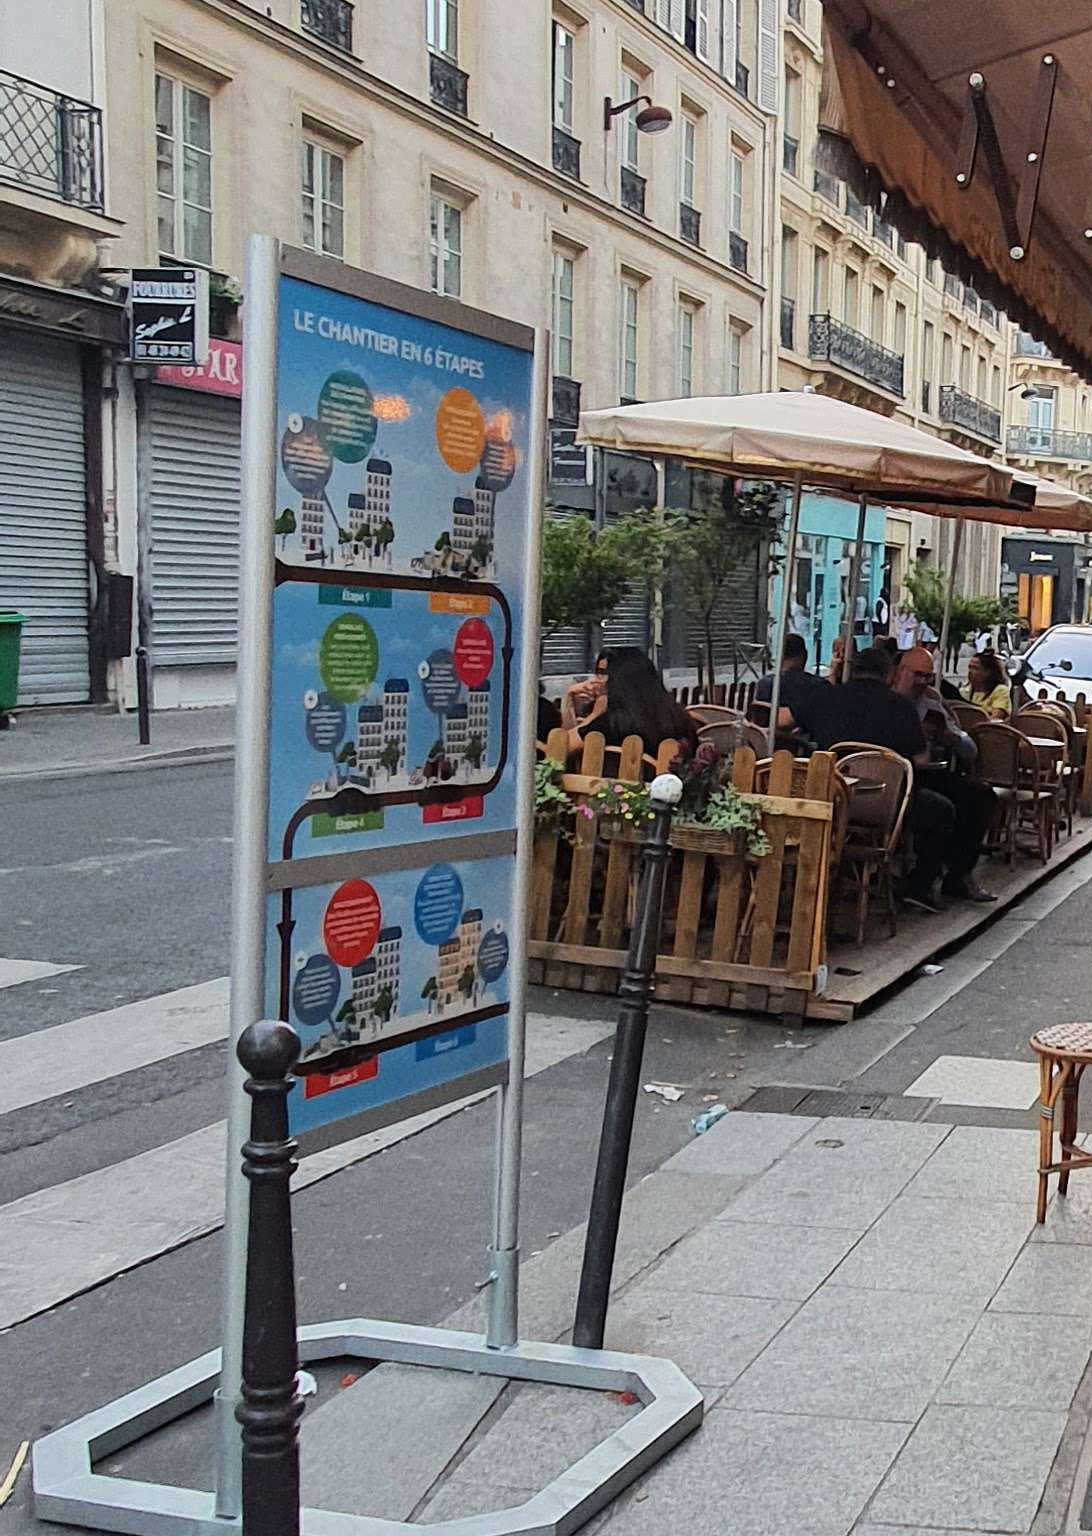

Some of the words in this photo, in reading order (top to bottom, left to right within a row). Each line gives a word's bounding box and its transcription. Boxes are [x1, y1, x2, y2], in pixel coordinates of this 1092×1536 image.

[293, 308, 315, 334] LE
[318, 316, 399, 357] CHANTIER
[401, 341, 422, 363] EN
[423, 348, 433, 366] 6
[435, 345, 485, 379] ÉTAPES
